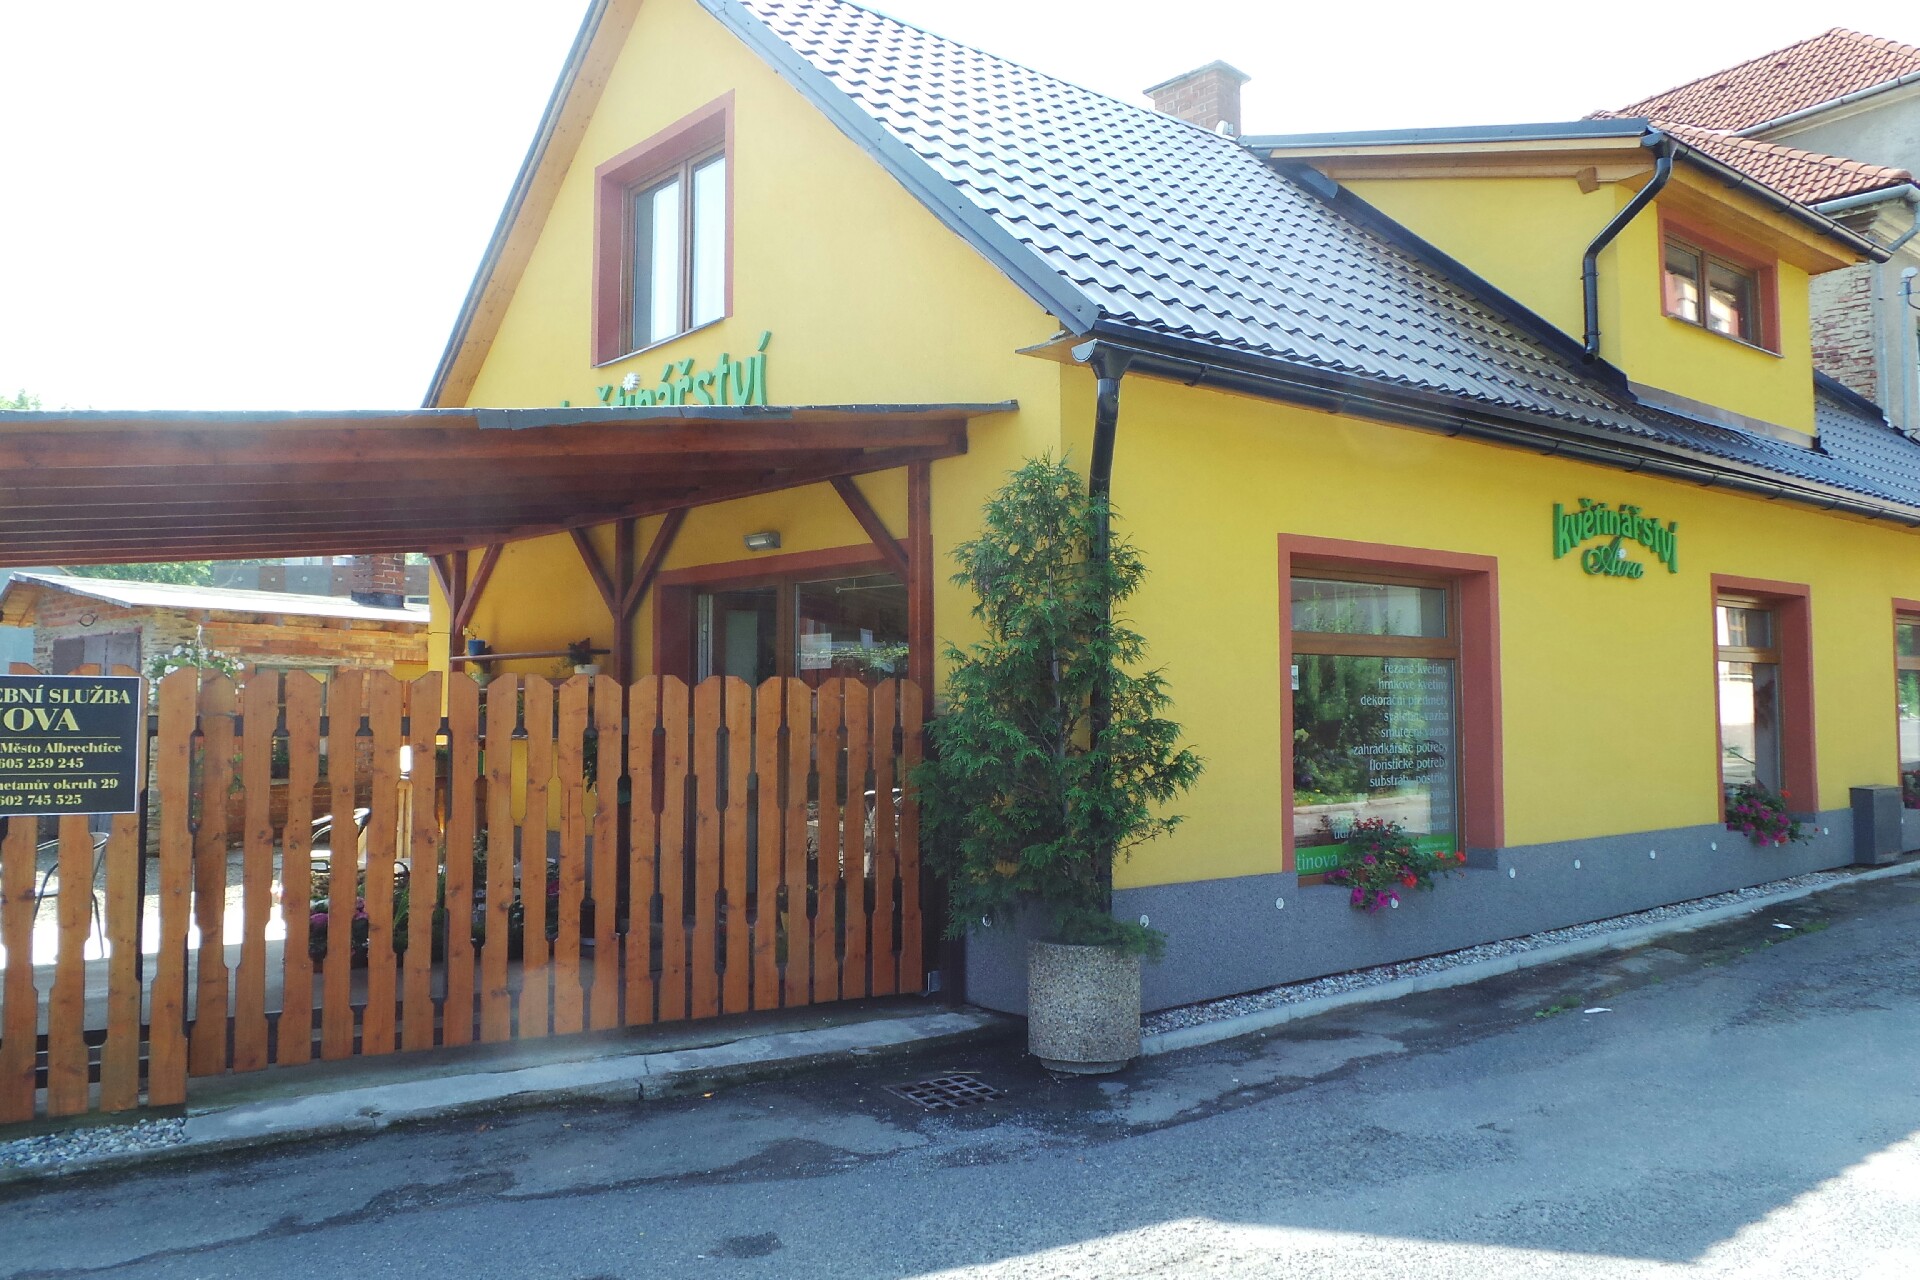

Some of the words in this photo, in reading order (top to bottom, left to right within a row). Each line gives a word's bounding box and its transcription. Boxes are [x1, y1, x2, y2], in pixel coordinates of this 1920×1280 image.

[1553, 497, 1679, 574] květinářství
[49, 685, 131, 704] SLUŽBA
[0, 707, 81, 732] OVA
[0, 742, 41, 753] Město
[44, 743, 122, 753] Albrechtice
[27, 758, 54, 769] 259
[57, 757, 84, 769] 245
[53, 779, 97, 790] okruh
[100, 778, 118, 789] 29
[27, 794, 51, 806] 745
[55, 794, 82, 805] 525
